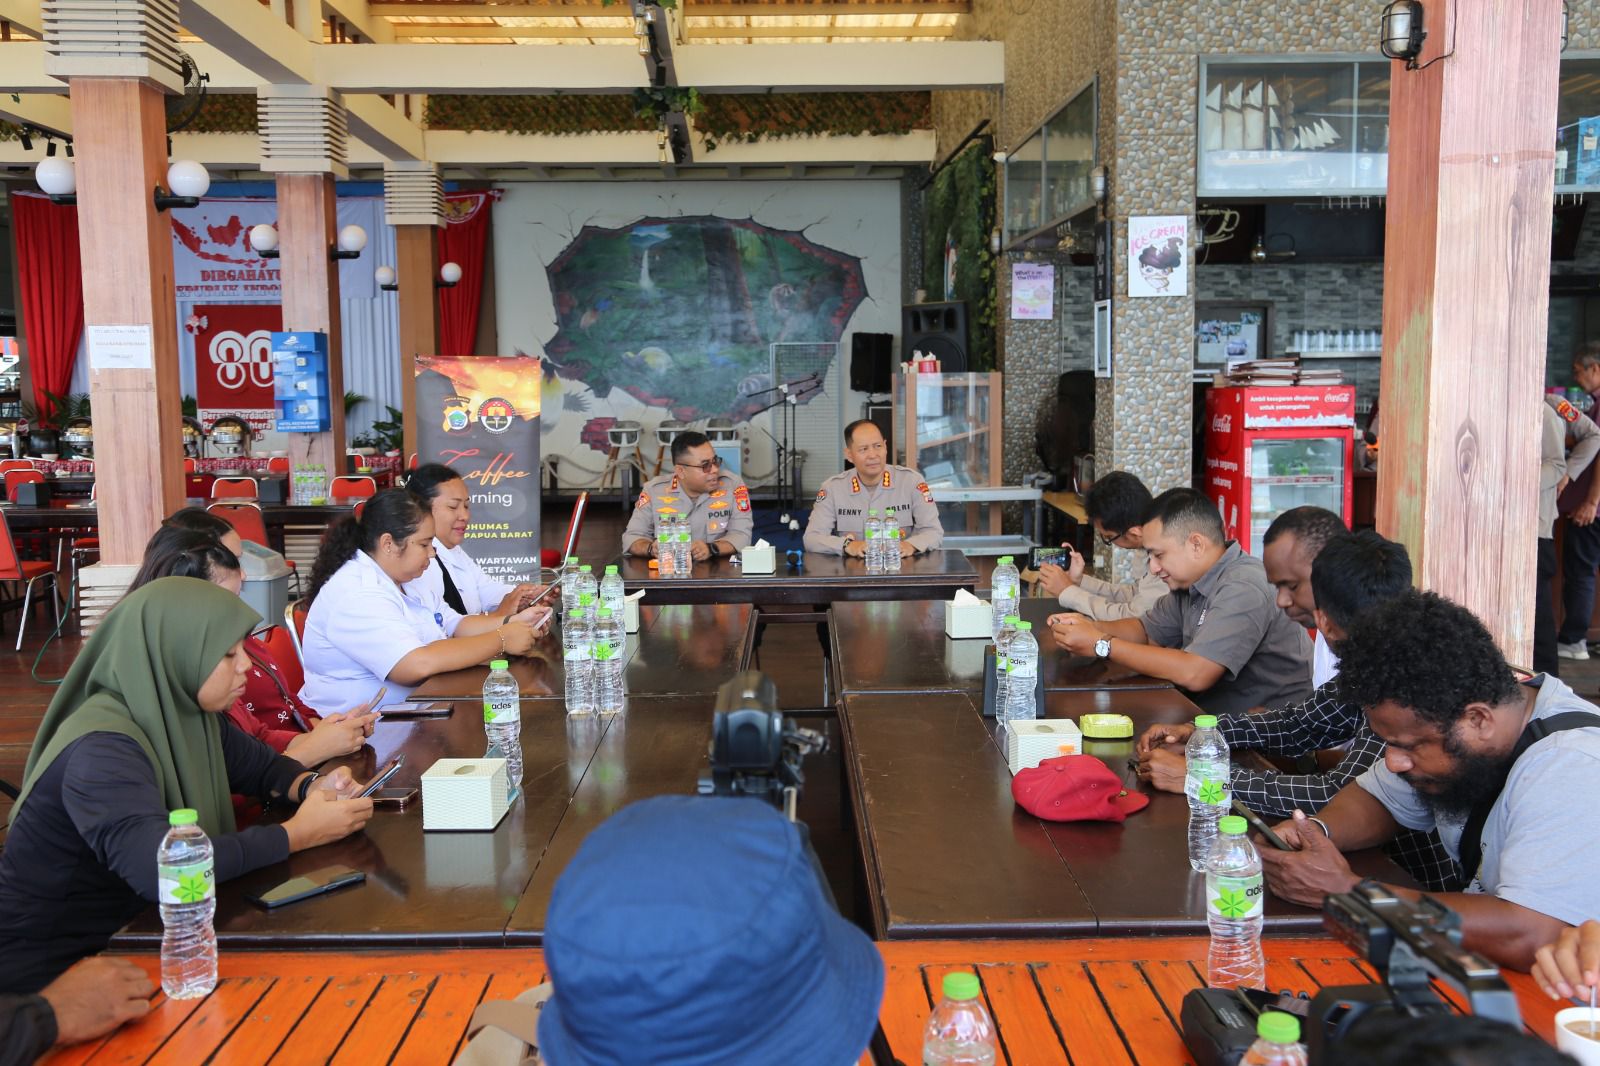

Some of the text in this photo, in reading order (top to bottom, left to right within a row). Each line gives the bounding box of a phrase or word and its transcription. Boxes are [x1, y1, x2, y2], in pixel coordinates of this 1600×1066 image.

[1150, 225, 1185, 239] CREAM
[208, 330, 274, 389] 80
[469, 491, 513, 507] rning
[708, 510, 732, 519] POLRI
[838, 508, 862, 516] BENNY
[476, 556, 537, 565] WARTAWAN
[482, 566, 517, 574] CETAK,
[1009, 658, 1027, 666] ades
[491, 702, 512, 711] ades
